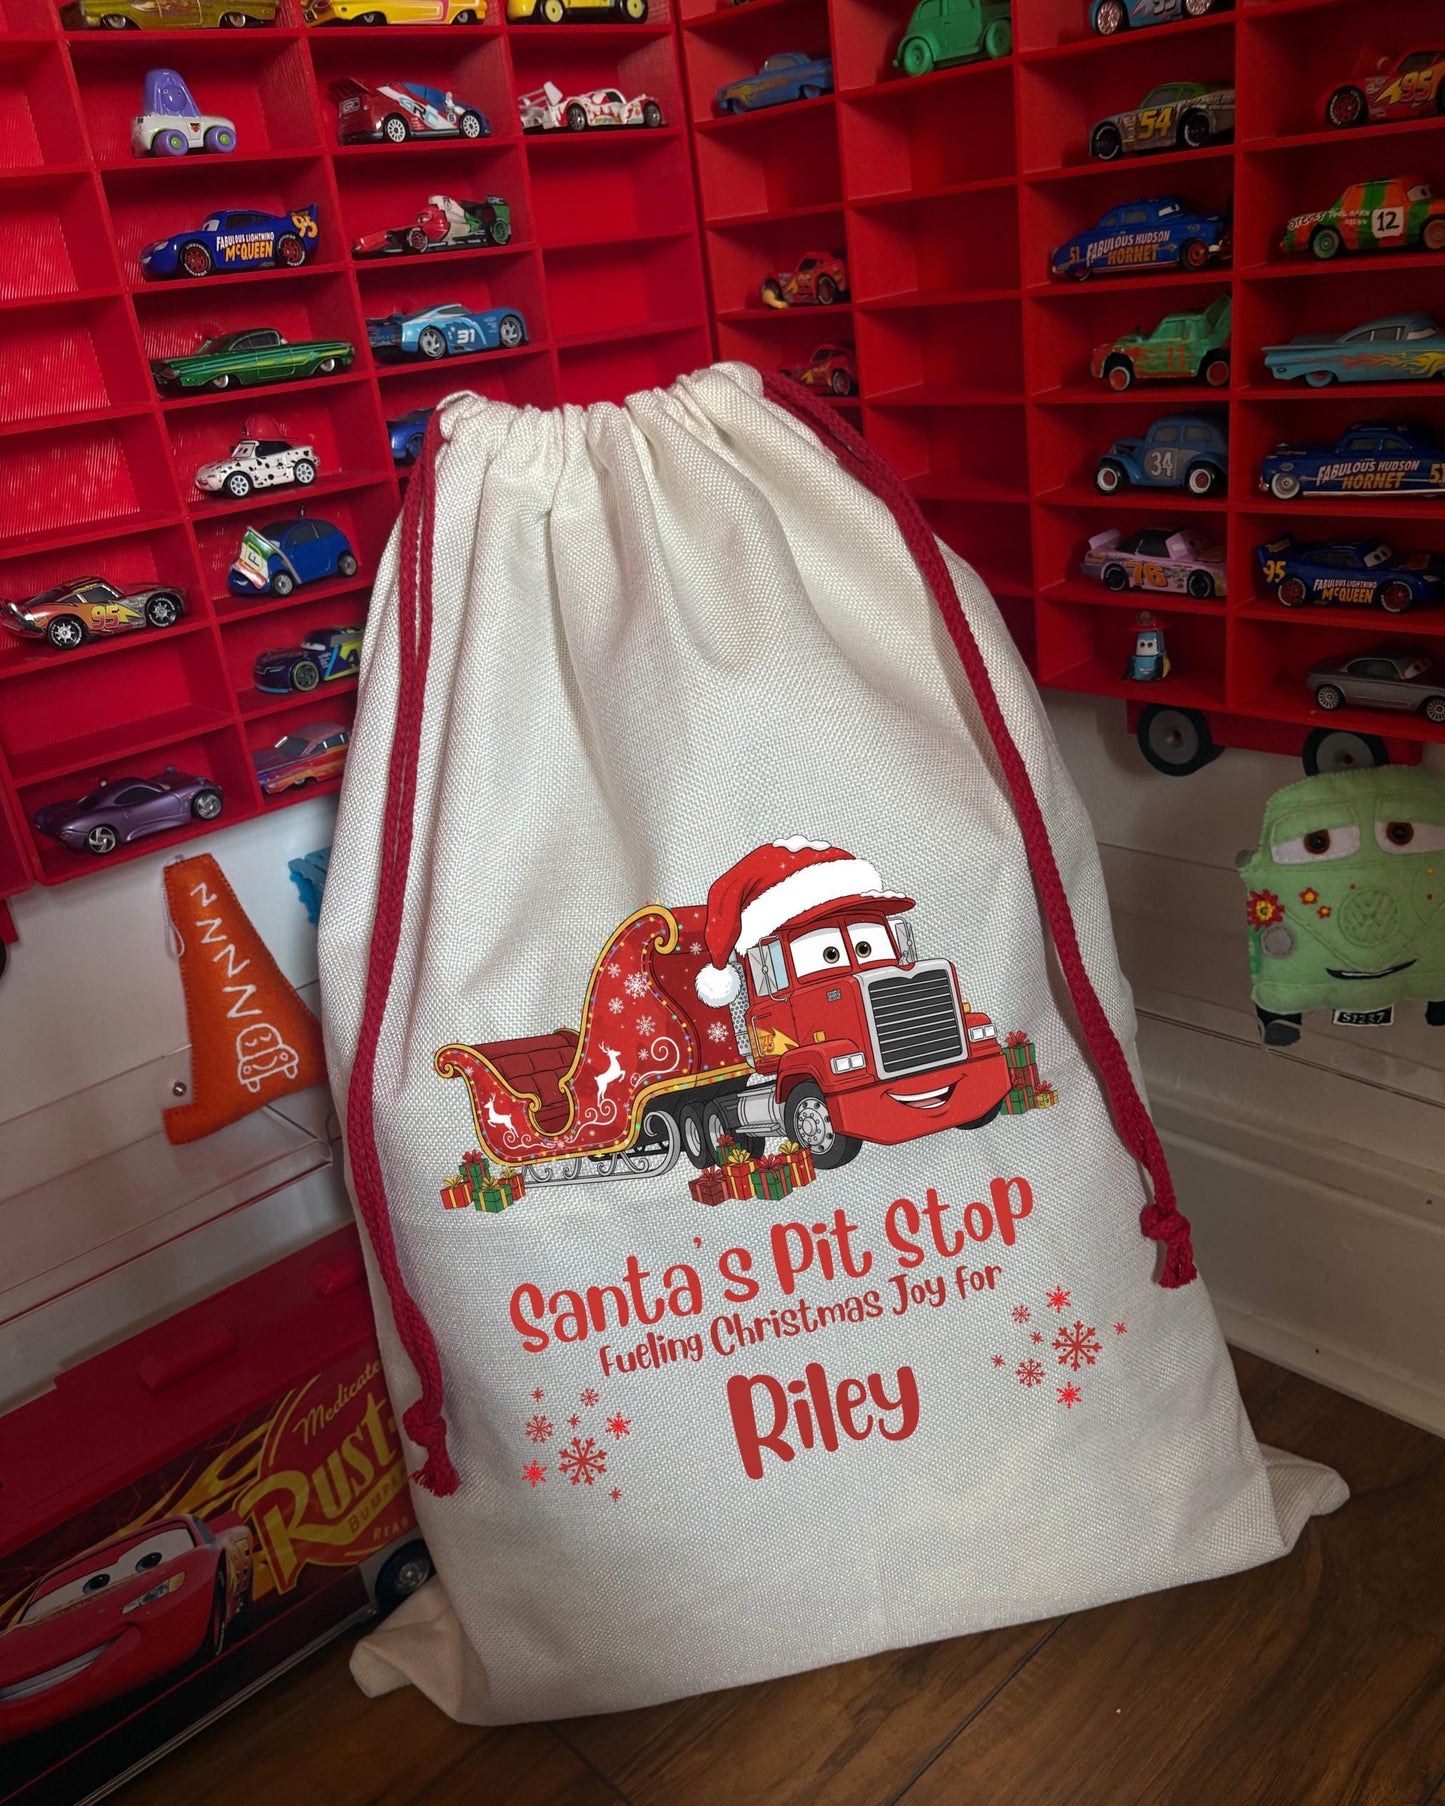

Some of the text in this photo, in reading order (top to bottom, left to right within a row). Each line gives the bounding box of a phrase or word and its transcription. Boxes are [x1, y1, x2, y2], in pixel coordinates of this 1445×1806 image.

[1402, 69, 1433, 103] 95
[1138, 106, 1173, 140] 54
[291, 214, 319, 238] 95
[1376, 211, 1401, 232] 12
[216, 231, 275, 252] FABULOUS LIGHTNING
[1086, 230, 1171, 267] FABULOUS HUDSON
[1069, 246, 1081, 264] 51
[1107, 245, 1160, 265] HORNET
[456, 328, 476, 345] 31
[1151, 451, 1174, 477] 34
[1315, 459, 1421, 487] FABULOUS HUDSON
[1341, 472, 1406, 489] HORNET
[1263, 559, 1287, 584] 95
[1312, 578, 1378, 591] FABULOUS LIGHTNING
[91, 605, 120, 630] 95
[510, 1176, 1035, 1353] Santa's Pit Stop
[598, 1265, 1003, 1377] Fueling Christmas Joy for
[726, 1362, 921, 1481] Riley
